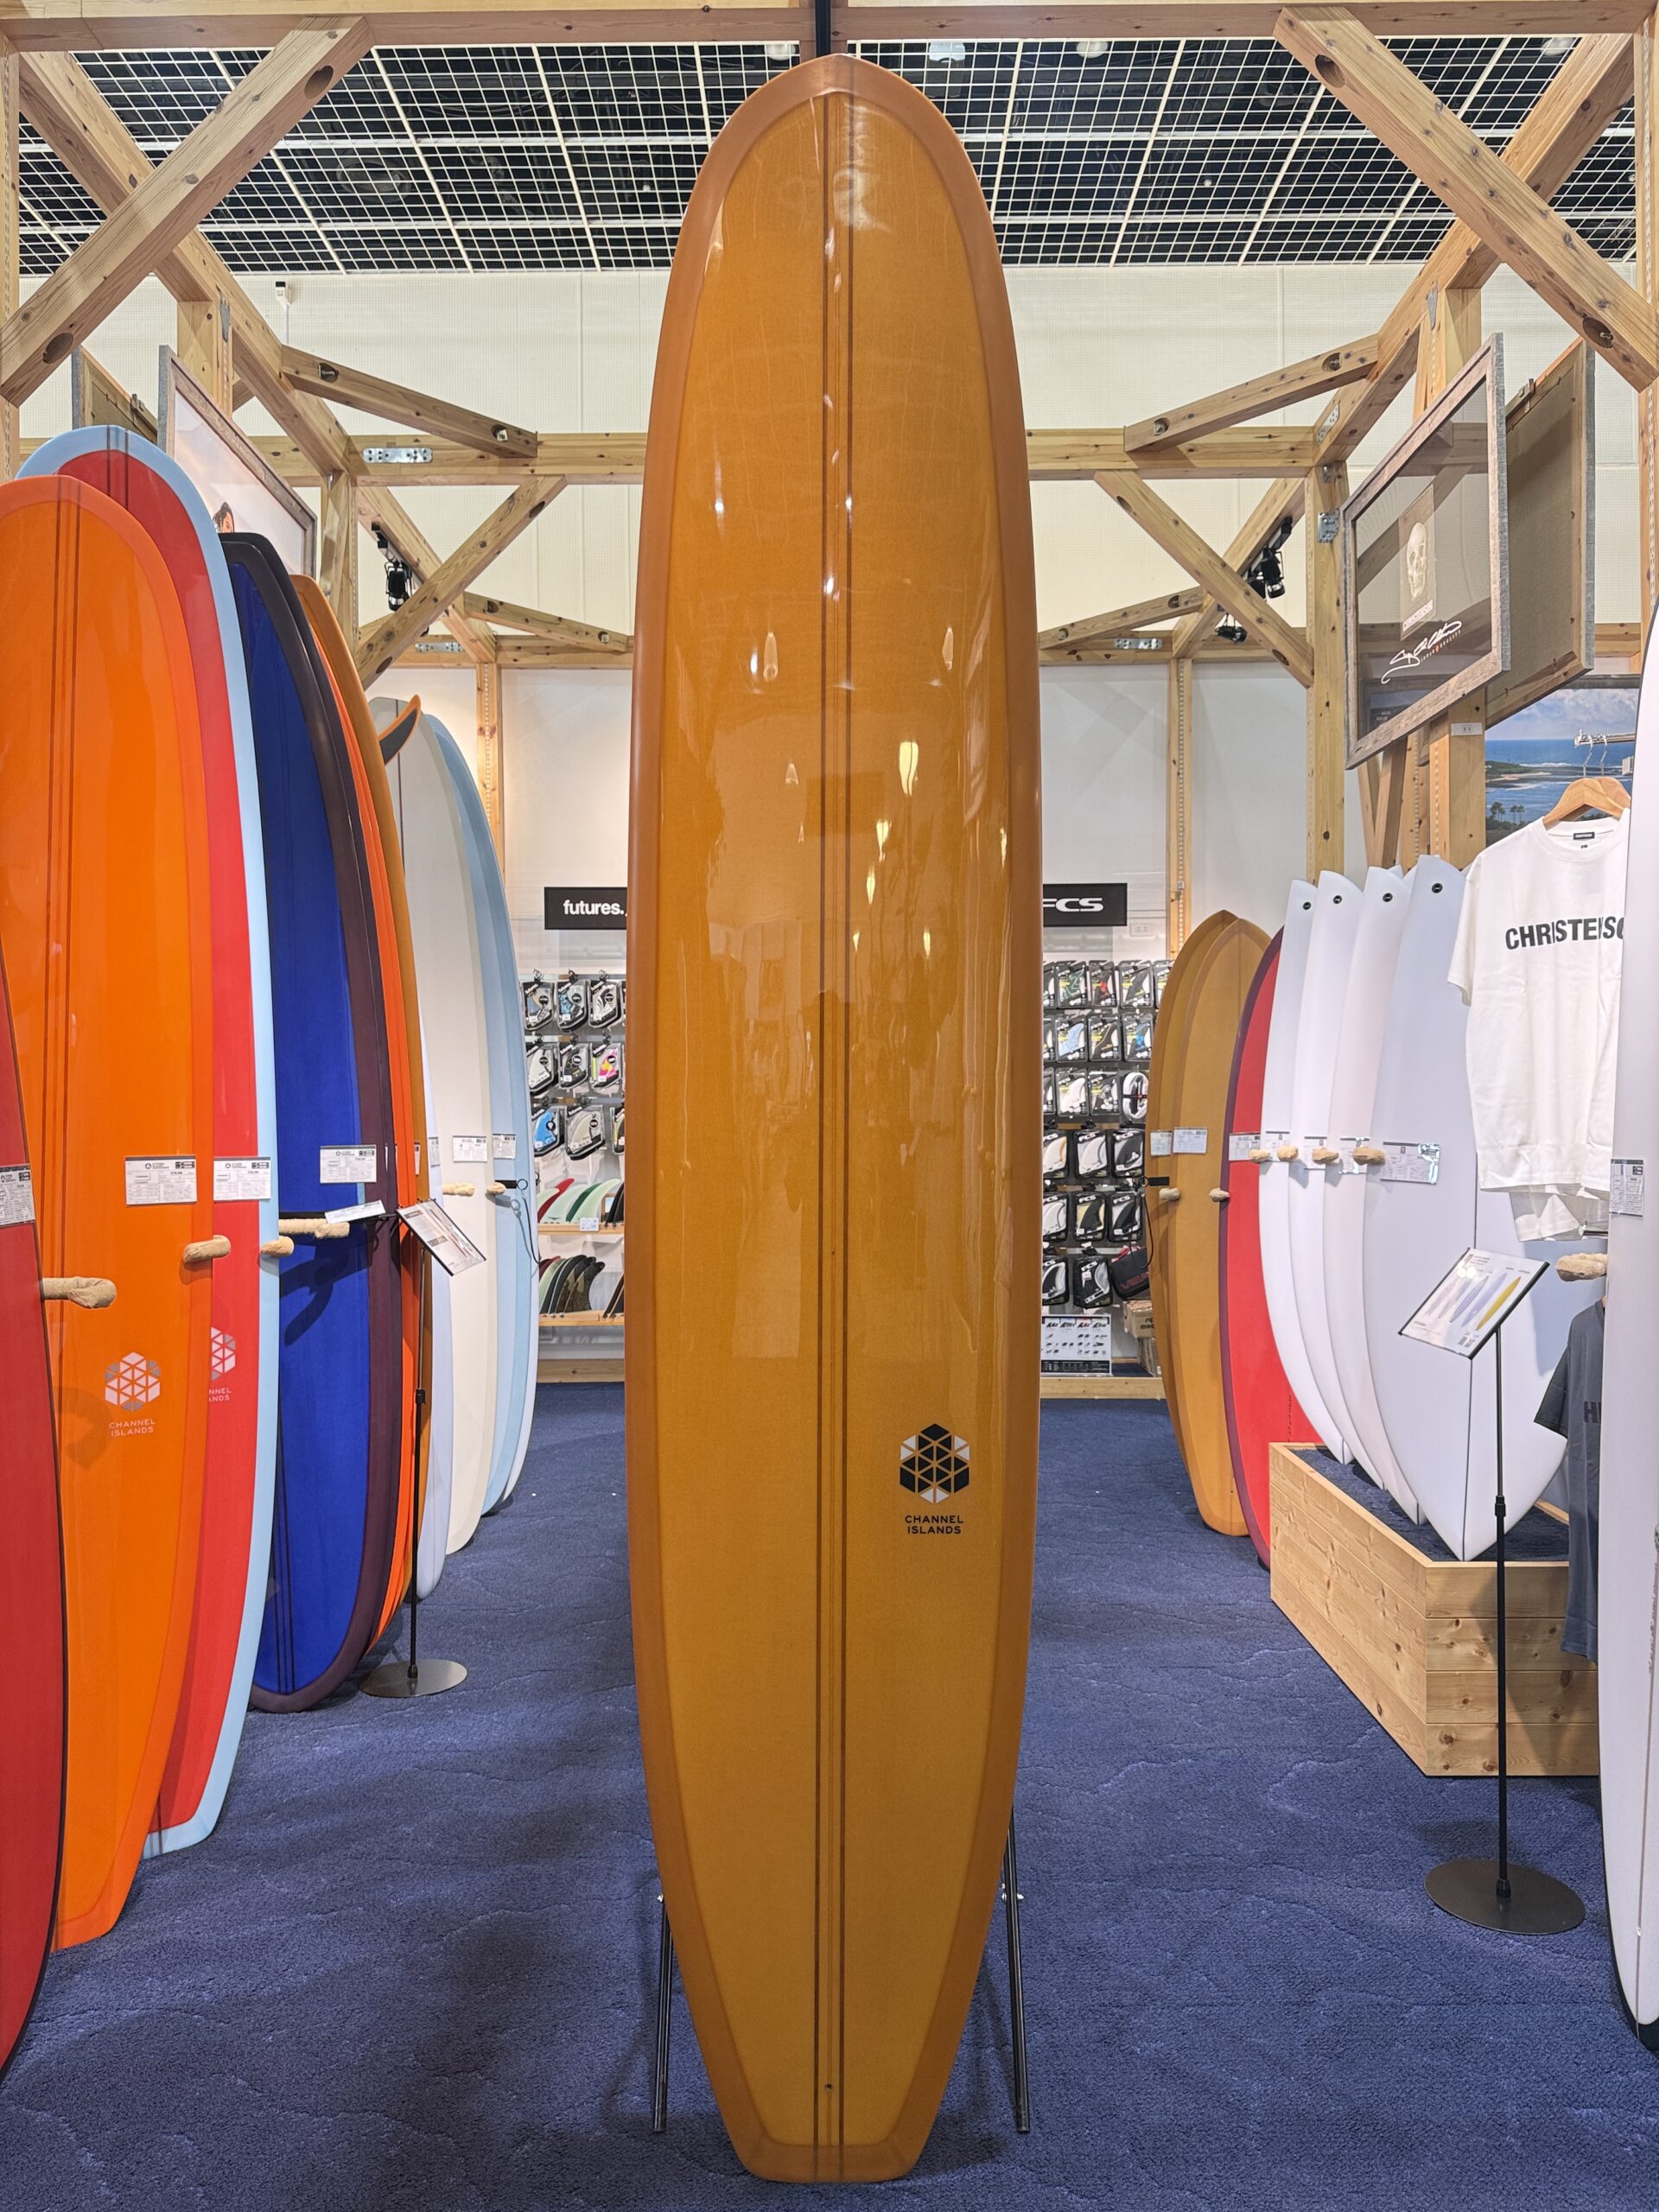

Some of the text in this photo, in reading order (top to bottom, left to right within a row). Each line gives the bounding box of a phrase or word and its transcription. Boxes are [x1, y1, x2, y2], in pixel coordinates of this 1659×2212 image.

[563, 899, 625, 915] futures.
[1043, 898, 1103, 912] FCS
[1113, 1195, 1130, 1204] FCS
[1081, 1261, 1097, 1272] FCS
[1584, 1401, 1601, 1423] H
[109, 1418, 156, 1429] CHANNEL
[111, 1427, 155, 1437] ISLANDS
[905, 1515, 964, 1523] CHANNEL
[907, 1525, 962, 1535] ISLANDS
